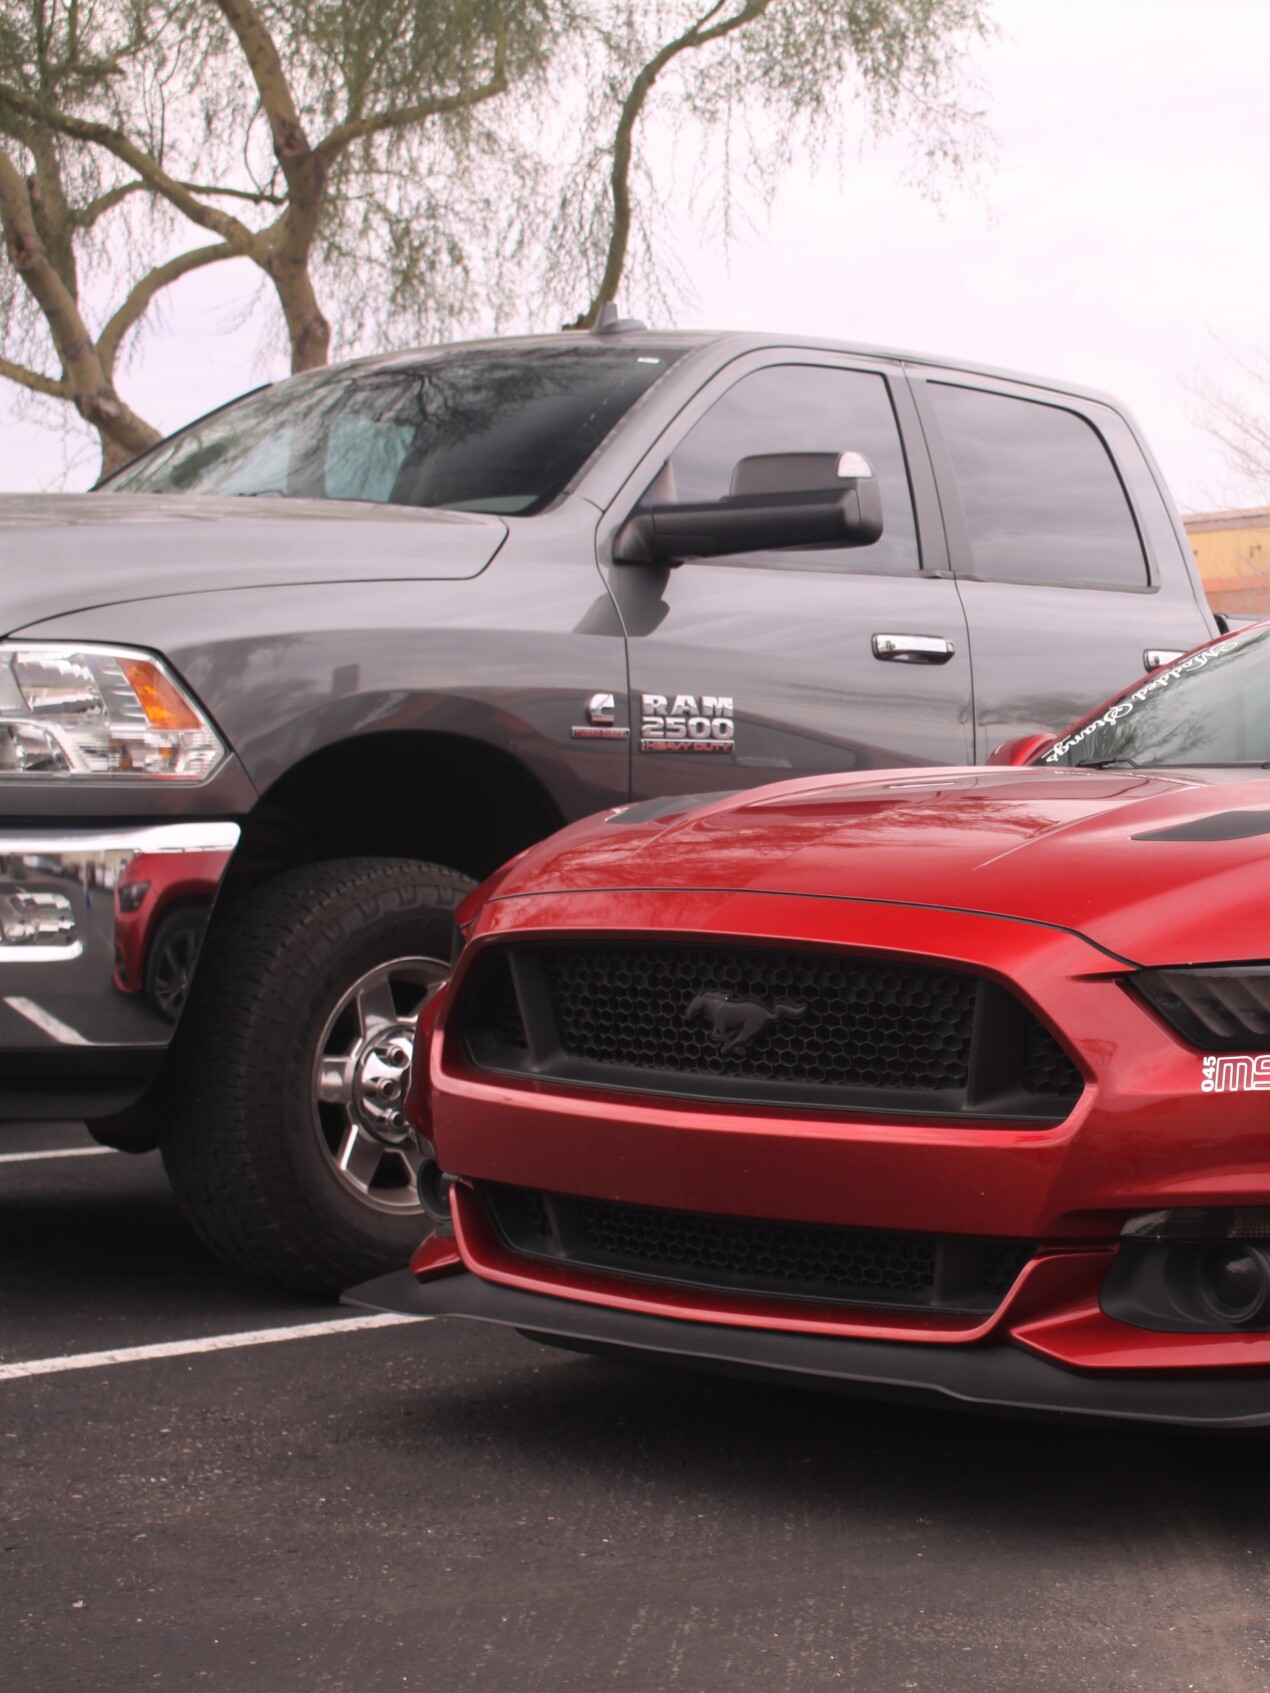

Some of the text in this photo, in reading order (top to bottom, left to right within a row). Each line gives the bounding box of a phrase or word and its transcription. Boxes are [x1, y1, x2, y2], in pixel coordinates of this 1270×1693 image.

[641, 694, 733, 717] RAM
[641, 716, 734, 739] 2500
[646, 741, 731, 752] HEAVY DUTY
[1201, 1055, 1217, 1093] 045
